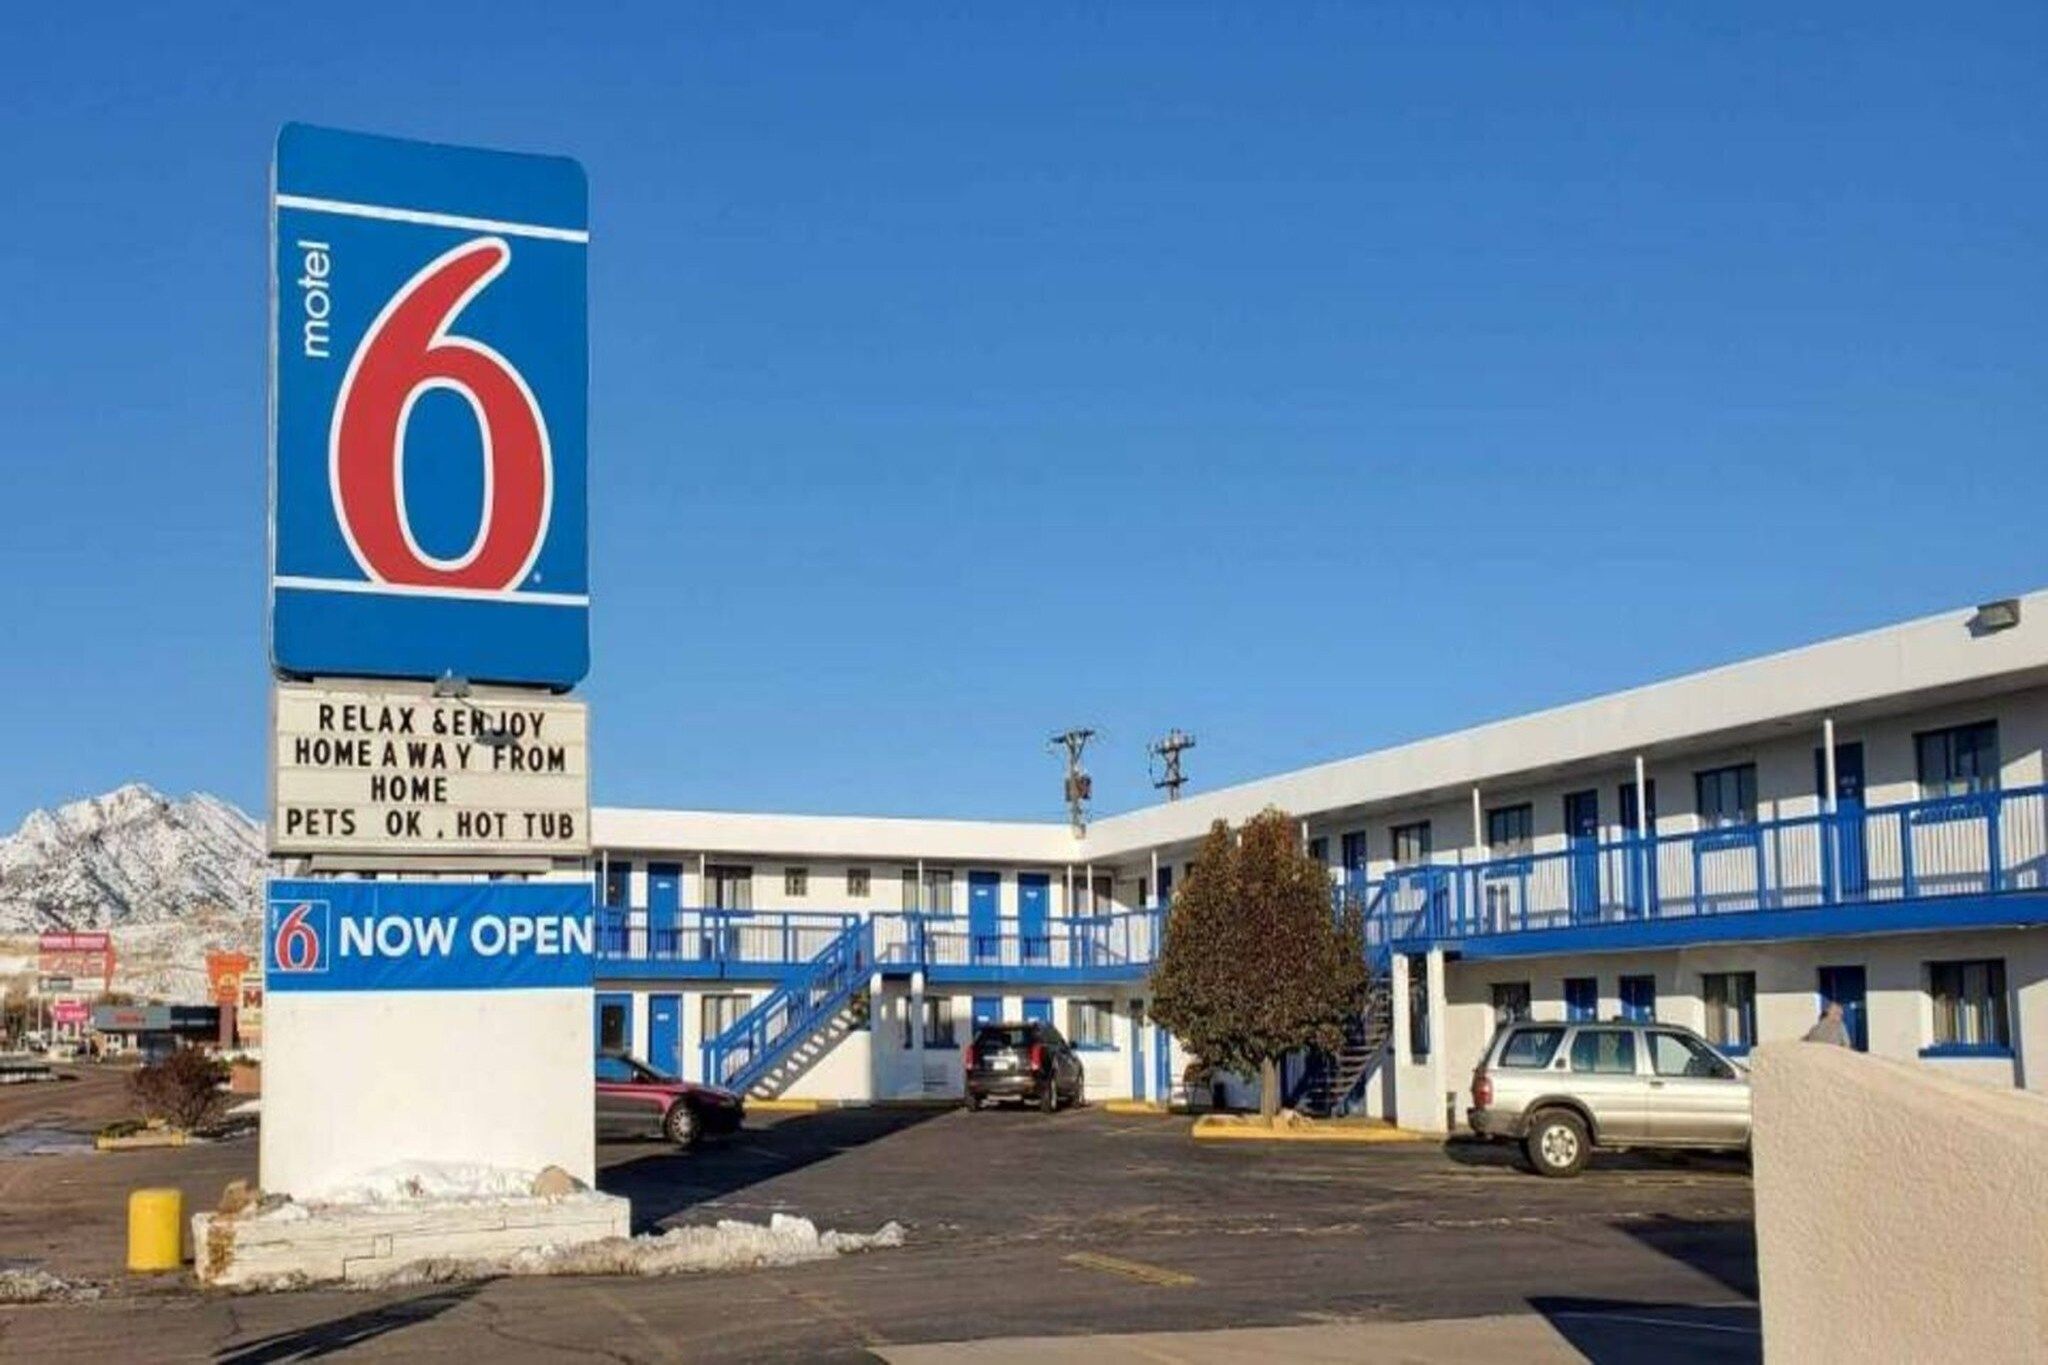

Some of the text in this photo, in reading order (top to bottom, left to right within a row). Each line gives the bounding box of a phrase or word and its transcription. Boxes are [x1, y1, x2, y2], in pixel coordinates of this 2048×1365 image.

[298, 236, 554, 593] motel 6
[319, 703, 415, 734] RELAX
[493, 743, 566, 773] FROM
[371, 774, 448, 803] HOME
[286, 807, 357, 836] PETS
[457, 810, 508, 839] HOT
[523, 812, 575, 840] TUB
[274, 903, 320, 972] 6
[339, 914, 594, 957] NOW OPEN
